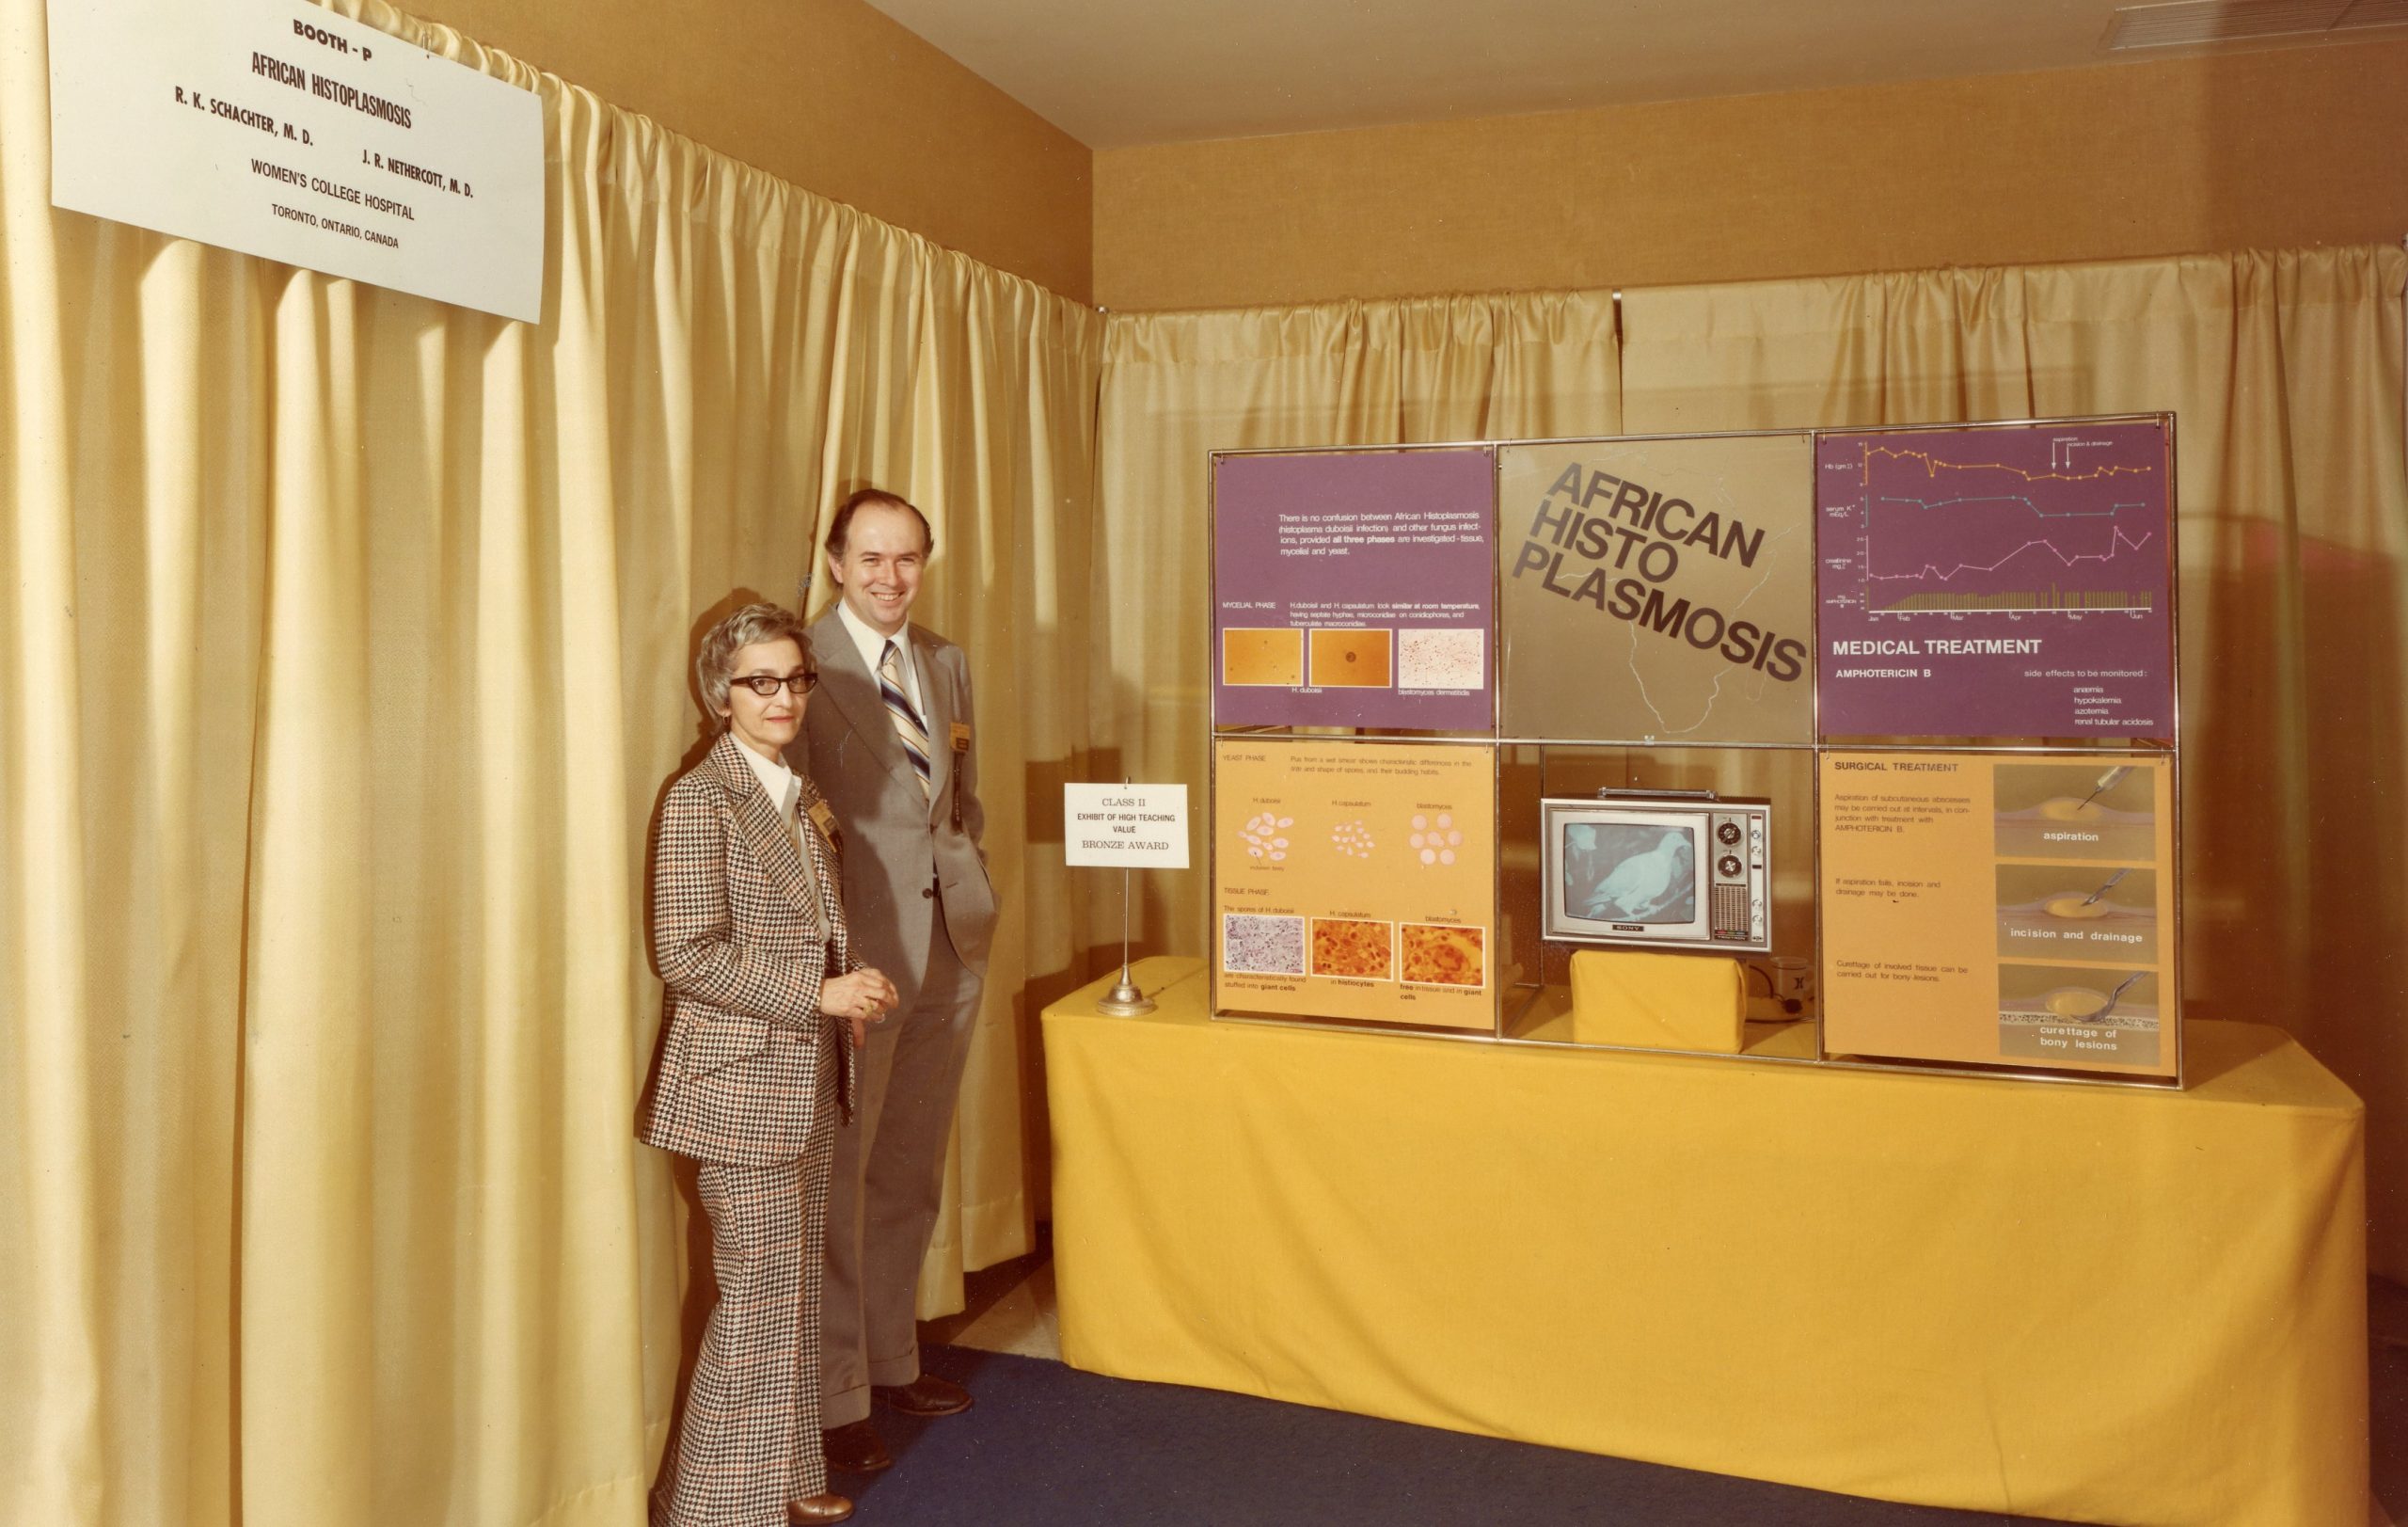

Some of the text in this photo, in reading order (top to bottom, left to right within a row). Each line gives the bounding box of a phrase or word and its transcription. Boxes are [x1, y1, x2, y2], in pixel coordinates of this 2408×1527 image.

[293, 19, 348, 54] BOOTH
[362, 47, 372, 61] P
[252, 52, 411, 129] AFRICAN HISTOPLASMOSIS
[175, 86, 313, 146] R. K. SCHACHTER, M. D.
[362, 149, 473, 199] J. R. NETHERCOTT, M. D.
[251, 158, 415, 221] WOMEN'S COLLEGE HOSPITAL
[272, 203, 399, 249] TORONTO, ONTARIO, CANADA
[1301, 514, 1308, 522] is
[1323, 514, 1358, 522] confusion
[1360, 513, 1392, 521] between
[1394, 512, 1421, 521] African
[1423, 512, 1480, 521] Histoplasmosis
[1545, 461, 1766, 568] AFRICAN
[1408, 523, 1428, 532] other
[1431, 523, 1457, 533] fungus
[1299, 535, 1331, 545] provided
[1333, 535, 1342, 544] all
[1343, 534, 1365, 544] three
[1367, 534, 1396, 545] phases
[1412, 534, 1456, 544] investigated
[1529, 499, 1679, 583] HISTO
[1280, 548, 1309, 557] mycelial
[1311, 547, 1326, 555] and
[1512, 540, 1807, 682] PLASMOSIS
[1833, 639, 2042, 655] MEDICAL TREATMENT
[1835, 669, 1931, 678] AMPHOTERICIN B
[2045, 669, 2075, 677] effects
[2074, 696, 2122, 706] hypokalemia
[2121, 718, 2154, 726] acidosis
[1834, 762, 1959, 772] SURGICAL TREATMENT
[1101, 798, 1146, 807] CLASS II
[1077, 813, 1176, 822] EXHIBIT OF HIGH TEACHING
[1113, 825, 1136, 834] VALUE
[2043, 832, 2099, 842] aspiration
[1082, 840, 1169, 851] BRONZE AWARD
[2010, 928, 2143, 944] incision and drainage
[1260, 983, 1278, 992] giant
[2039, 1026, 2117, 1039] curettage of
[2040, 1037, 2118, 1051] bony lesions
